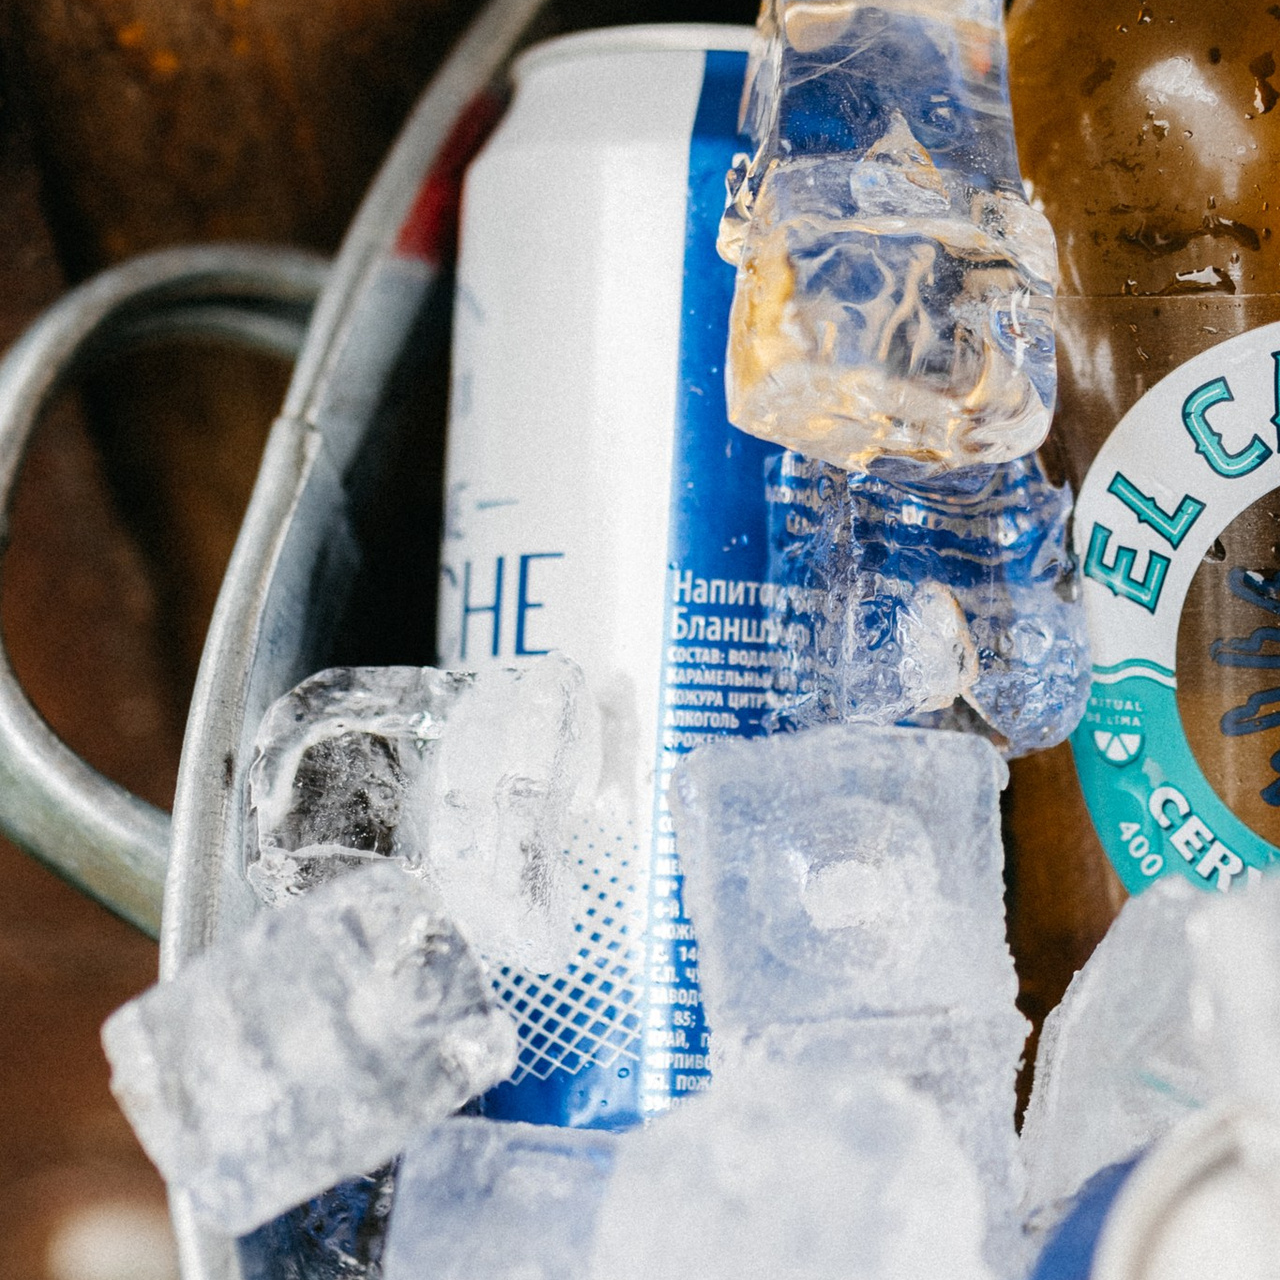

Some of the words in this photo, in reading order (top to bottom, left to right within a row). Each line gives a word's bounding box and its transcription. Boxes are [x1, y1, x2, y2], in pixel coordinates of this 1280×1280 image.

[1084, 471, 1206, 615] EL
[442, 552, 565, 662] HE
[666, 646, 725, 665] СОСТАВ:
[664, 688, 723, 707] КОЖУРА
[663, 709, 739, 729] АЛКОГОЛЬ
[1107, 714, 1142, 727] LIMA
[1118, 821, 1164, 877] 400
[674, 1011, 696, 1028] 85;
